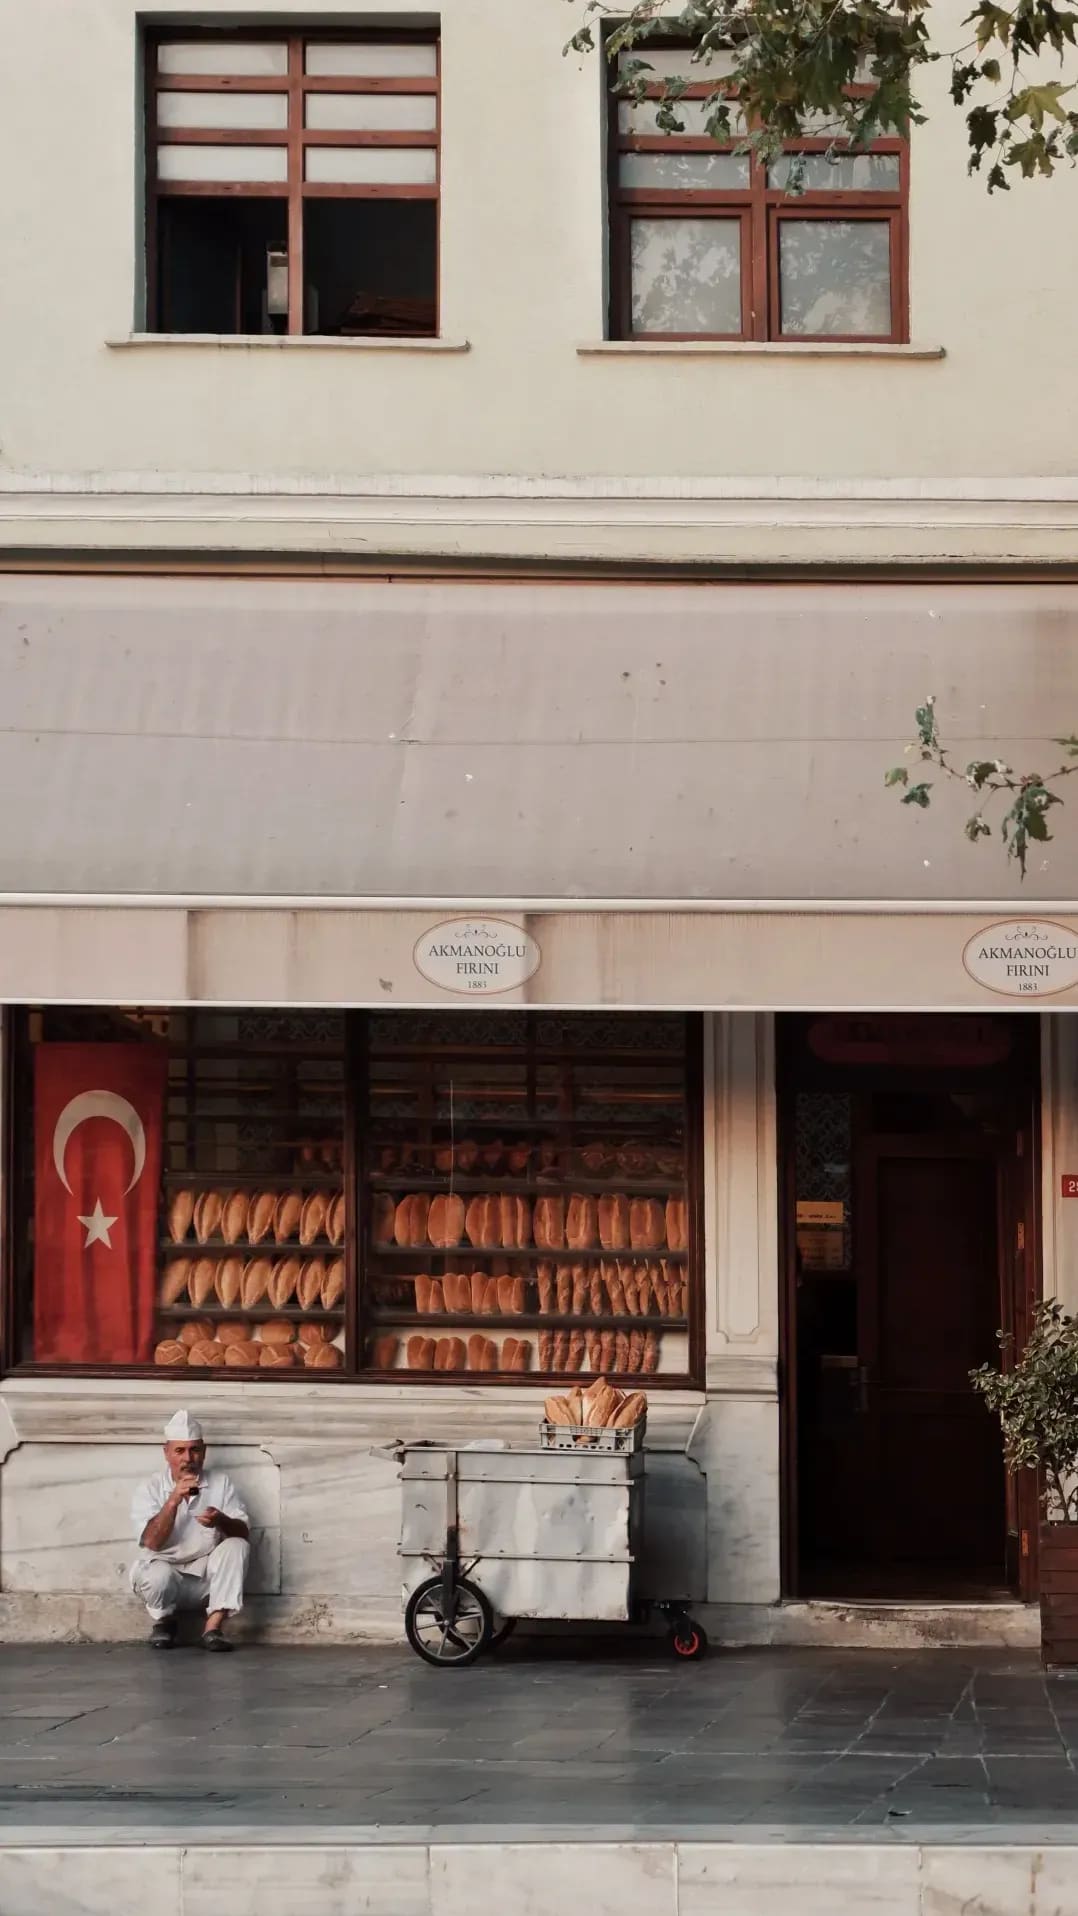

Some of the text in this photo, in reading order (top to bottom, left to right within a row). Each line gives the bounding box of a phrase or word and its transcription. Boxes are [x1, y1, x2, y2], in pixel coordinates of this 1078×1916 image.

[428, 943, 526, 958] AKMANOĞLU
[978, 945, 1077, 959] AKMANOĞLU
[456, 962, 500, 975] FIRINI
[1006, 964, 1050, 976] FIRINI
[468, 981, 487, 989] 1883
[1018, 983, 1038, 992] 1883
[1069, 1180, 1078, 1193] 2
